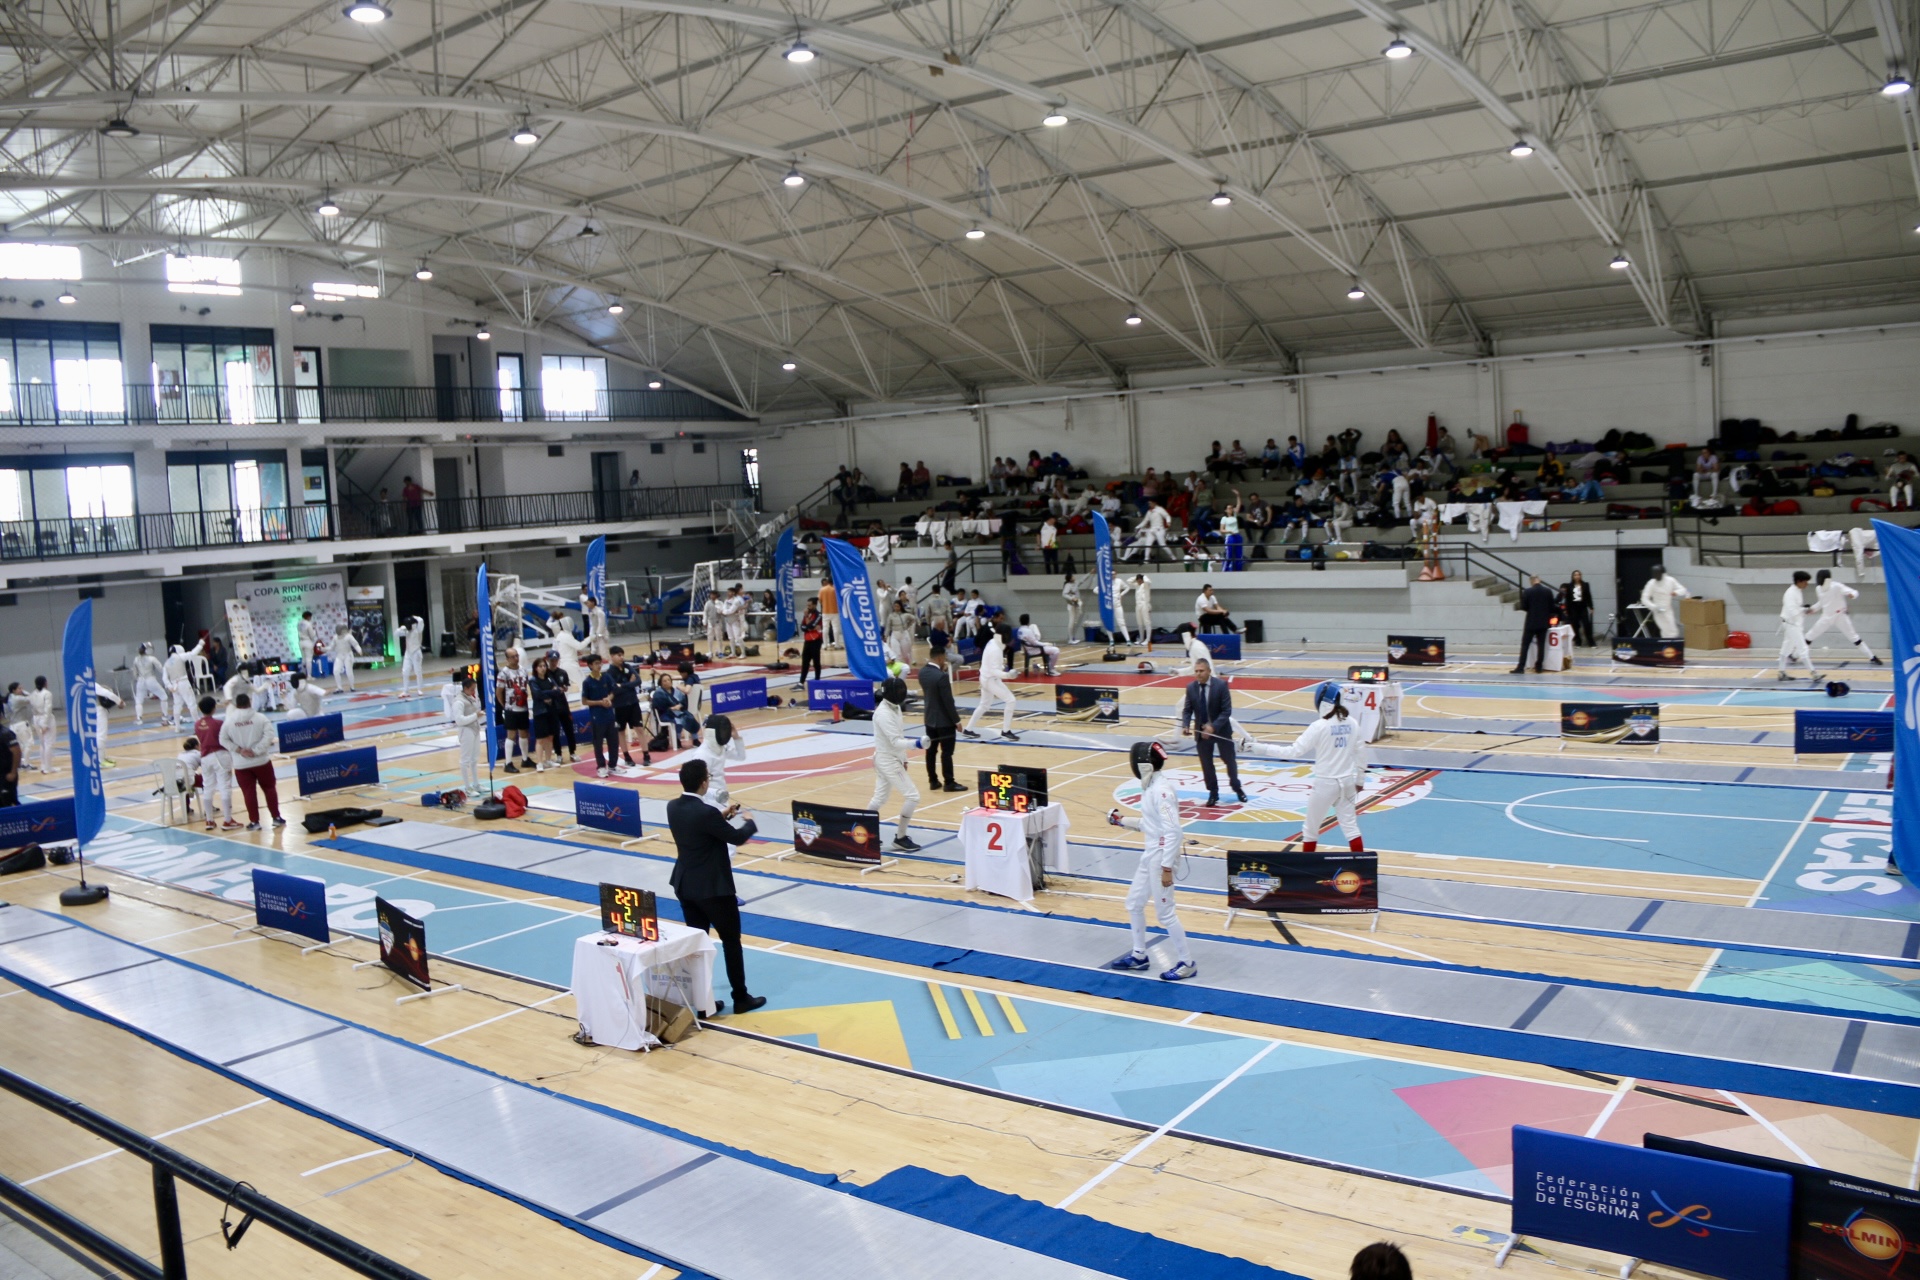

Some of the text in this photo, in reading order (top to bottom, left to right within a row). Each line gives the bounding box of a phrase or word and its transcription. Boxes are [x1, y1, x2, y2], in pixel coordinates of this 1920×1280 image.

[254, 581, 328, 598] COPA RIONEGRO
[282, 594, 302, 604] 2024
[785, 560, 794, 623] Electrolit
[852, 575, 881, 658] Electrolit
[1548, 631, 1559, 647] 6
[1364, 691, 1377, 711] 4
[983, 791, 997, 809] 12
[1013, 794, 1027, 812] 12
[986, 822, 1004, 851] 2
[258, 890, 288, 902] Federación
[614, 888, 638, 907] 2:27
[260, 901, 289, 913] De ESGRIMA
[610, 912, 622, 933] 4
[640, 917, 657, 941] 15
[1535, 1171, 1640, 1199] Federación
[1828, 1179, 1891, 1198] @COLMINEXSPORTS
[1535, 1181, 1640, 1209] Colombiana
[1535, 1192, 1640, 1221] De ESGRIMA
